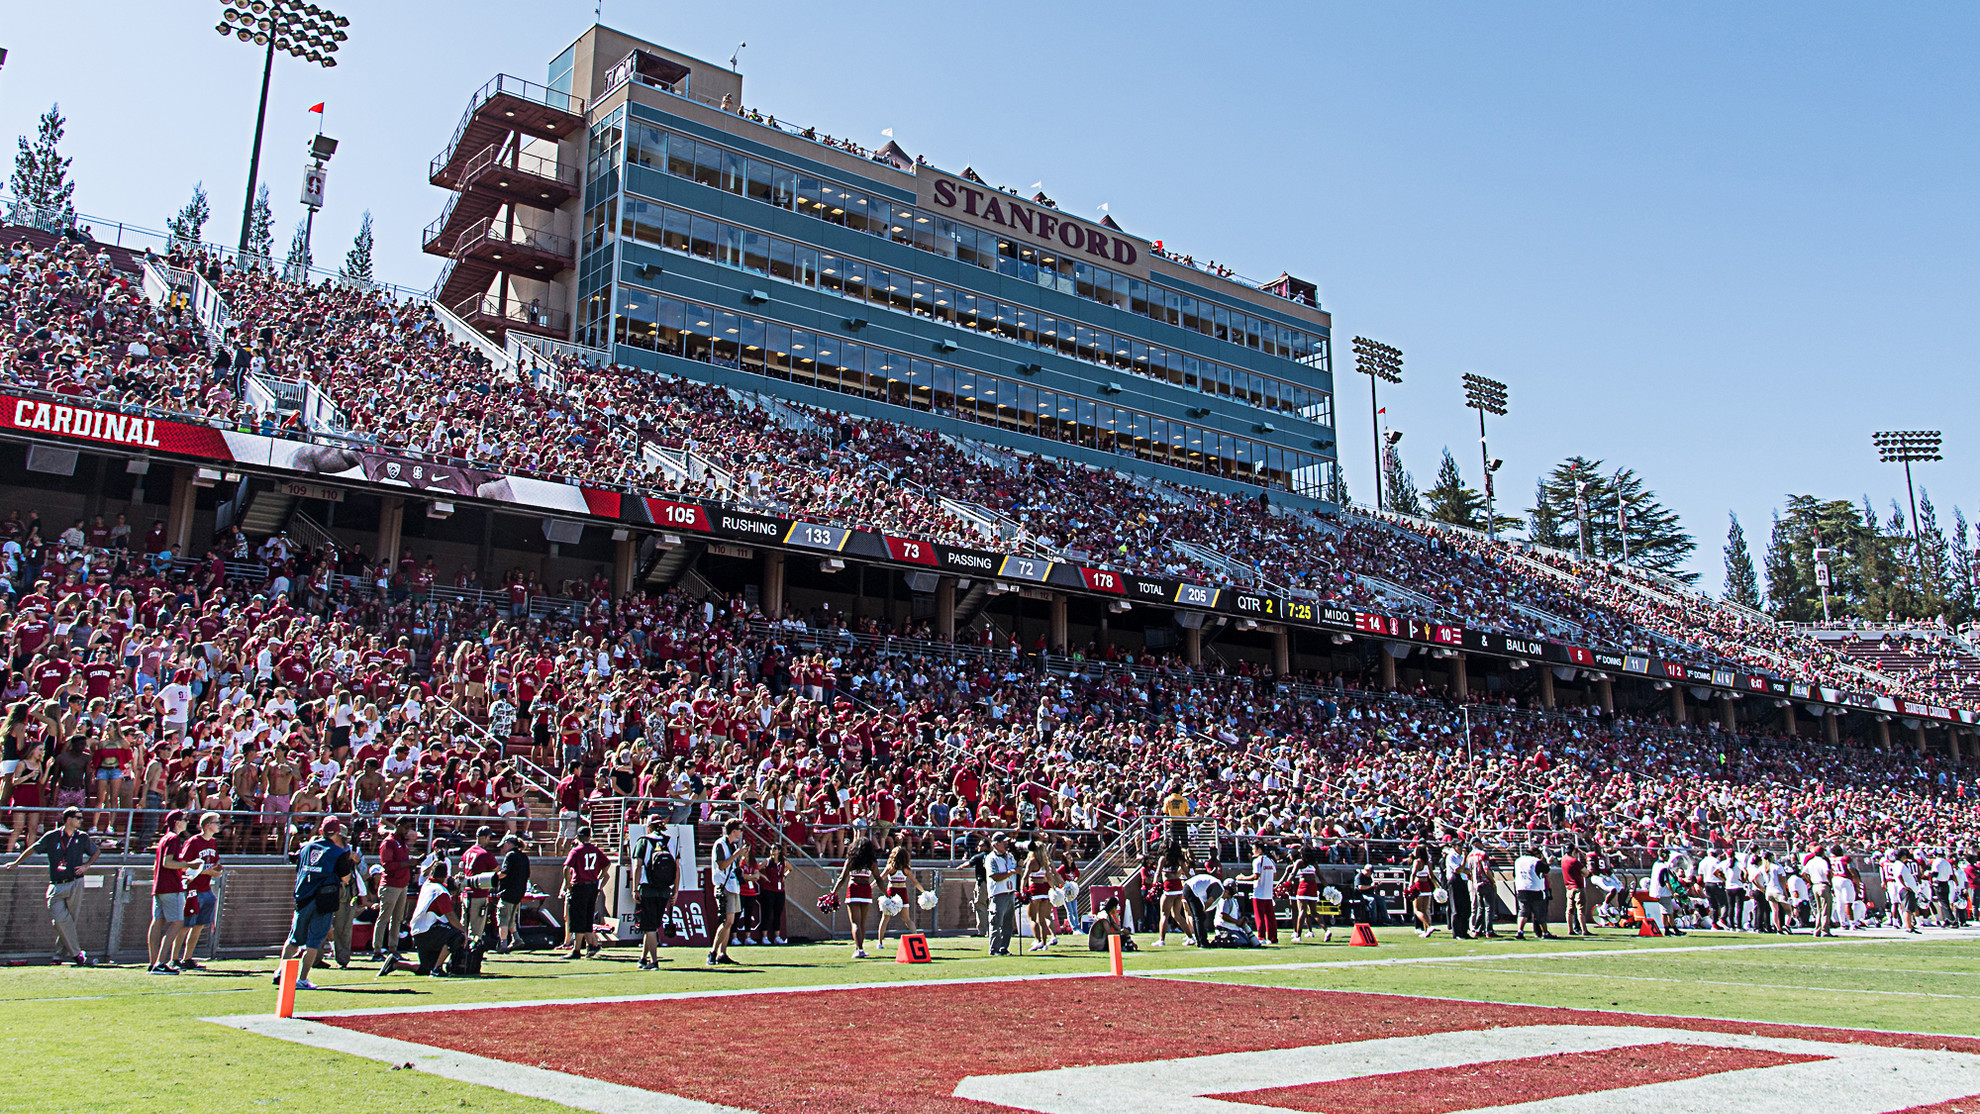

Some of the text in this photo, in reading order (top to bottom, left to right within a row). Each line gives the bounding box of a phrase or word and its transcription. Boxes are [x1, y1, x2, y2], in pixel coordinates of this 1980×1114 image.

[934, 179, 1137, 265] STANFORD
[14, 399, 160, 447] CARDINAL
[288, 484, 338, 500] 109 110
[665, 505, 831, 545] 105 RUSHING 133
[737, 548, 748, 557] 111
[903, 542, 1033, 576] 73 PASSING 72
[1093, 572, 1207, 603] 178 TOTAL 205
[1237, 595, 1273, 613] QTR 2
[1288, 602, 1311, 620] 7:25
[1368, 616, 1380, 631] 14
[1440, 627, 1451, 642] 10
[1481, 635, 1543, 656] & BALL ON
[1631, 659, 1639, 670] 11
[465, 852, 477, 871] 17
[584, 852, 597, 871] 17
[1598, 859, 1606, 870] 9
[672, 905, 689, 941] GET
[690, 902, 707, 938] GET
[1359, 926, 1376, 945] 10
[908, 937, 928, 960] G
